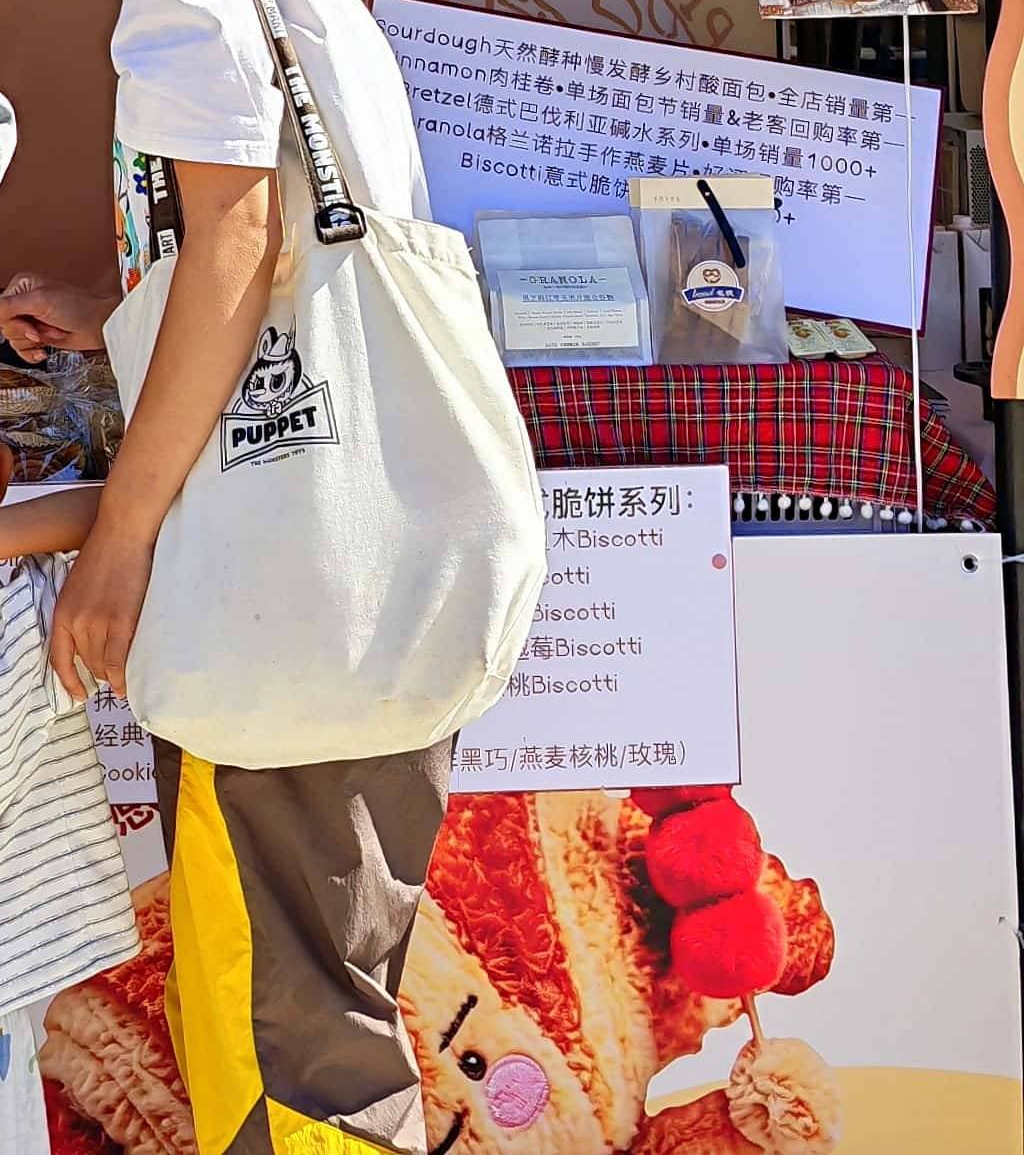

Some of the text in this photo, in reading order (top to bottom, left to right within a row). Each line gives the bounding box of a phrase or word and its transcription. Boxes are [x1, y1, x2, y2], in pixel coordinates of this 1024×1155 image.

[284, 64, 305, 109] THE
[395, 51, 907, 151] innamon肉桂卷•单场面包节销量&老客回购率第一
[231, 405, 317, 448] PUPPET
[545, 526, 664, 551] 木Biscotti
[501, 673, 619, 698] 桃Biscotti
[94, 721, 152, 748] 经典
